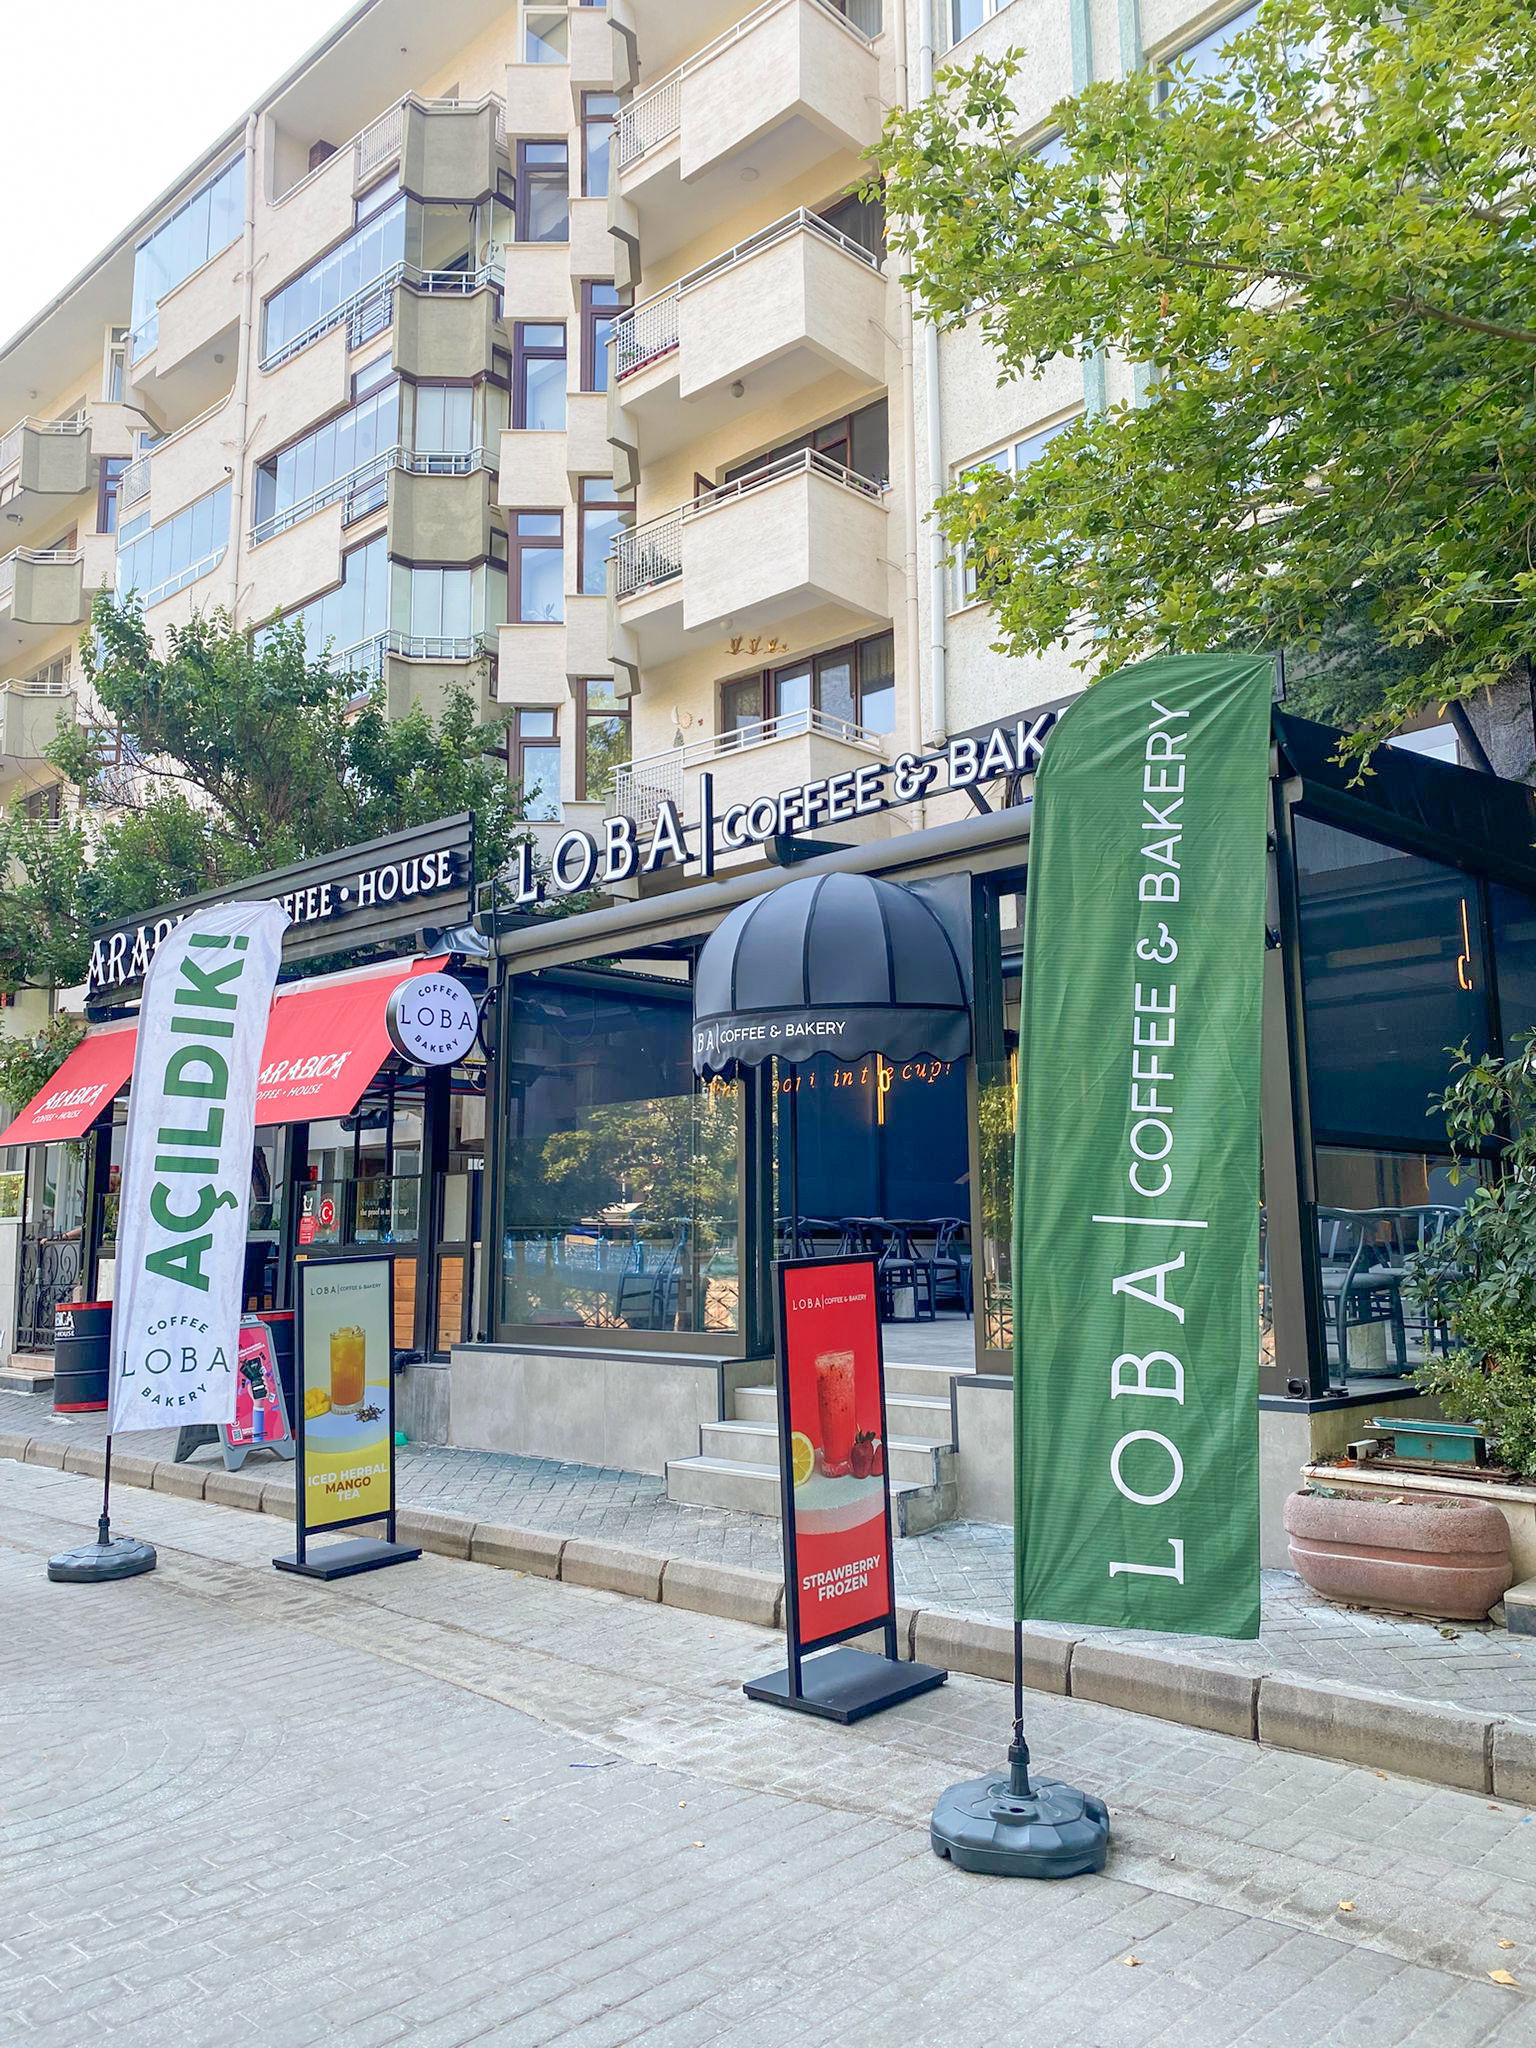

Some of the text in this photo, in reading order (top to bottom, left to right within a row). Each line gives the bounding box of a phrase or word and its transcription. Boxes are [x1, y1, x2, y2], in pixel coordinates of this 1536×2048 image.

[515, 703, 1071, 904] LOBA COFFEE & BAK
[357, 850, 452, 907] HOUSE
[418, 984, 459, 1001] COFFEE
[400, 1004, 474, 1032] LOBA
[414, 1034, 459, 1053] BAKERY
[720, 1026, 766, 1044] COFFEE
[770, 1025, 781, 1038] &
[786, 1021, 846, 1037] BAKERY
[258, 1051, 352, 1084] ARABICA
[33, 1083, 109, 1115] ARABICA
[256, 1083, 323, 1101] OFFEE HOUSE
[32, 1109, 83, 1124] COFFEE HOUSE
[144, 932, 249, 1292] AÇILDIK!
[1109, 699, 1190, 1584] LOBA COFFEE & BAKERY
[310, 1286, 337, 1296] LOBA
[792, 1298, 821, 1311] LOBA
[824, 1296, 843, 1305] COFFEE
[848, 1294, 867, 1302] BAKERY
[147, 1316, 209, 1336] COFFEE
[121, 1347, 231, 1378] LOBA
[141, 1383, 208, 1407] BAKERY
[308, 1463, 388, 1487] ICED HERBAL
[325, 1476, 372, 1494] MANGO
[336, 1488, 361, 1502] TEA
[802, 1554, 880, 1590] STRAWBERRY
[818, 1573, 868, 1602] FROZEN
